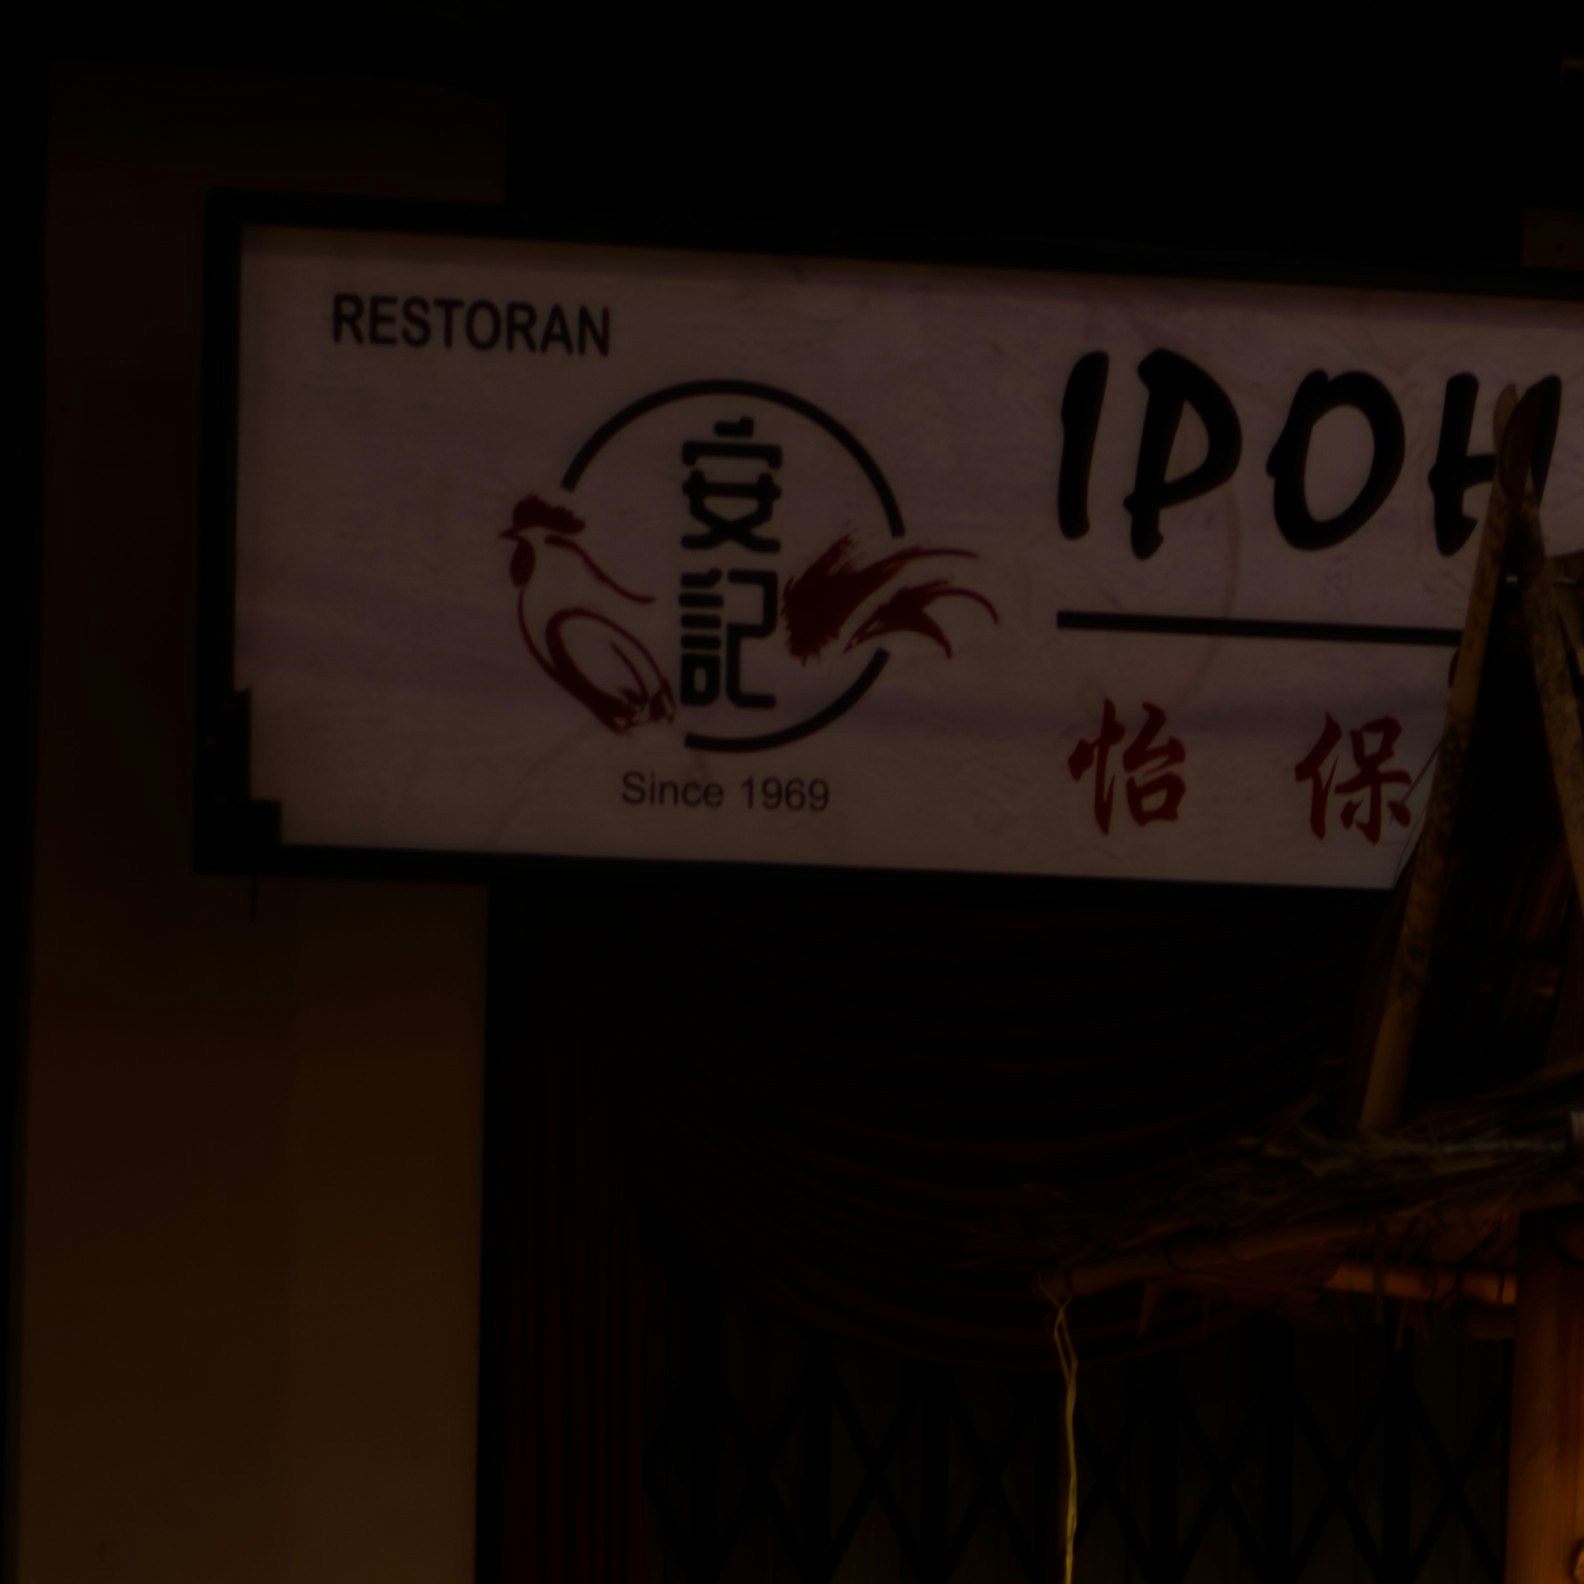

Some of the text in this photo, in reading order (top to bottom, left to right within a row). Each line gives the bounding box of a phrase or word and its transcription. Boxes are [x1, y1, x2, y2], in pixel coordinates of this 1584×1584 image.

[332, 293, 611, 357] RESTORAN
[1058, 349, 1562, 558] IPOH
[680, 416, 783, 709] 安記
[620, 770, 831, 811] Since 1969
